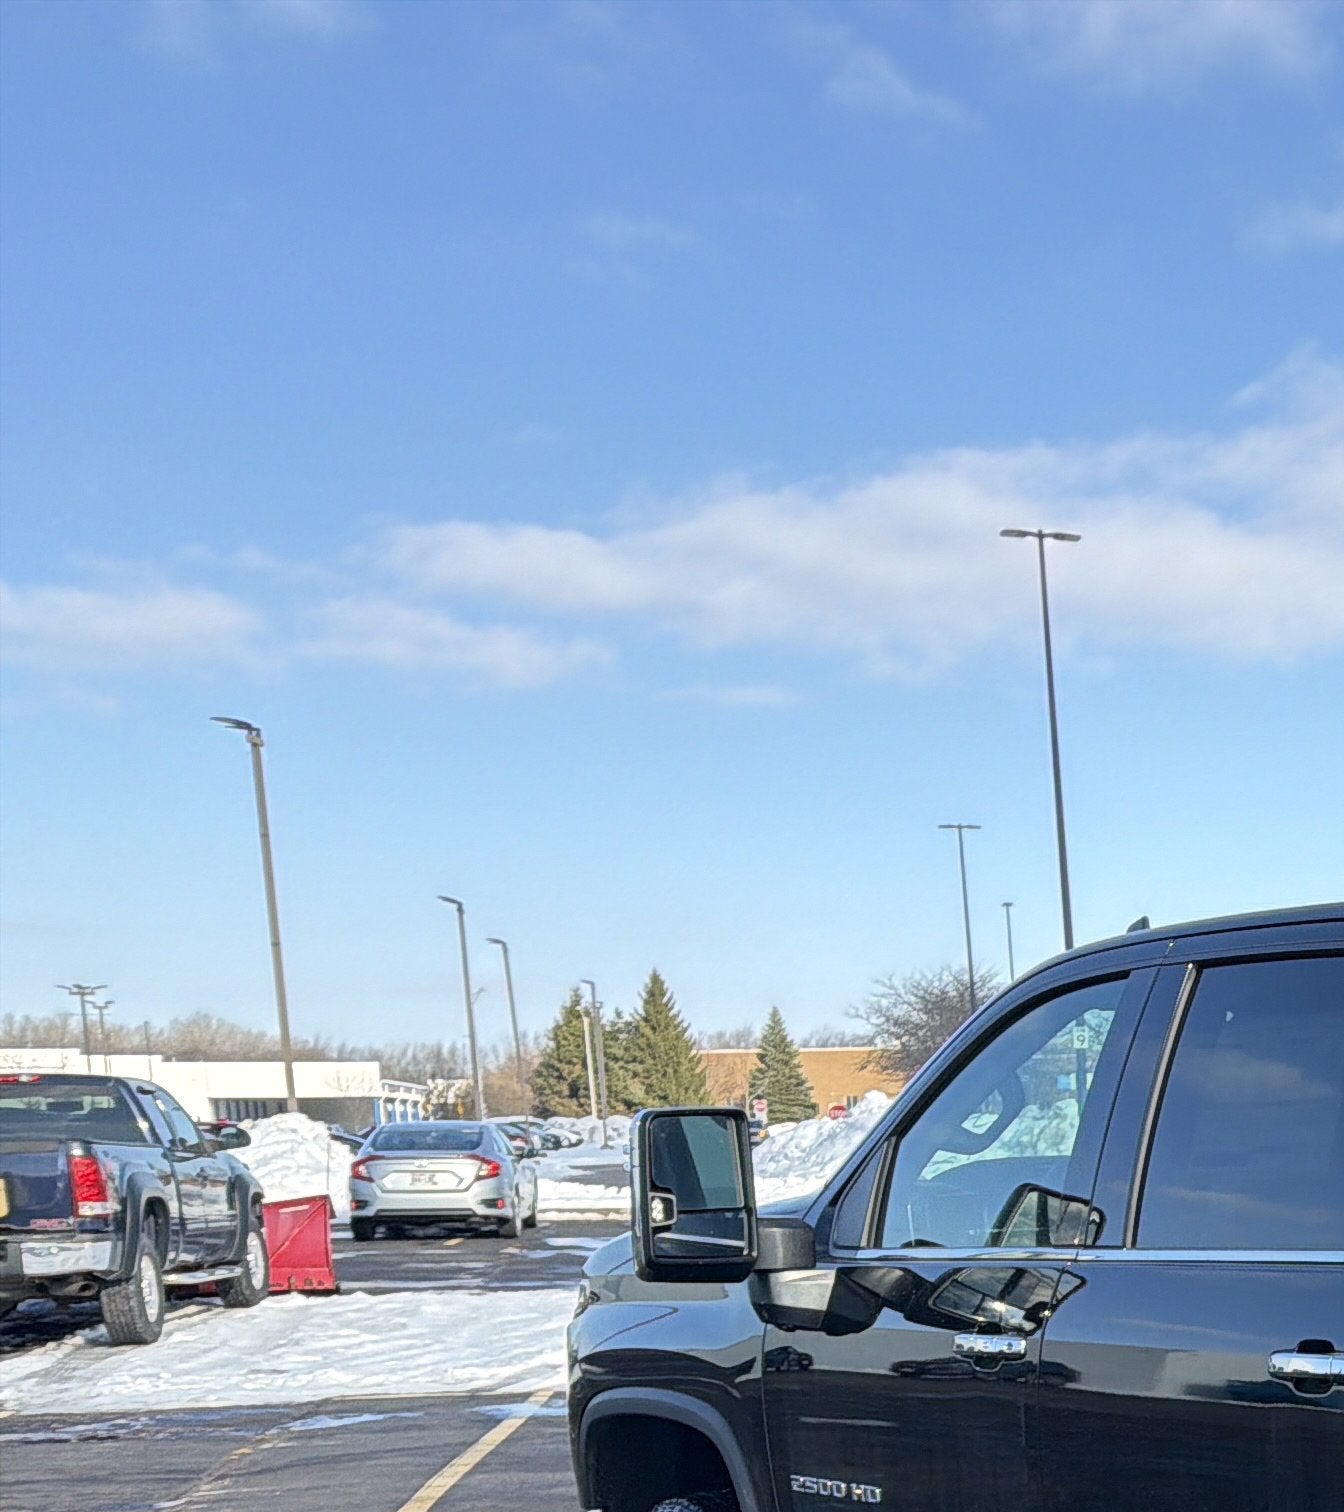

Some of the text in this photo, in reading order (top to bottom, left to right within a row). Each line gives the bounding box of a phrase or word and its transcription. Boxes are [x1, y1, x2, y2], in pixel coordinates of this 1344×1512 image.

[1076, 1034, 1086, 1047] 9
[789, 1474, 882, 1503] 2500 HD
